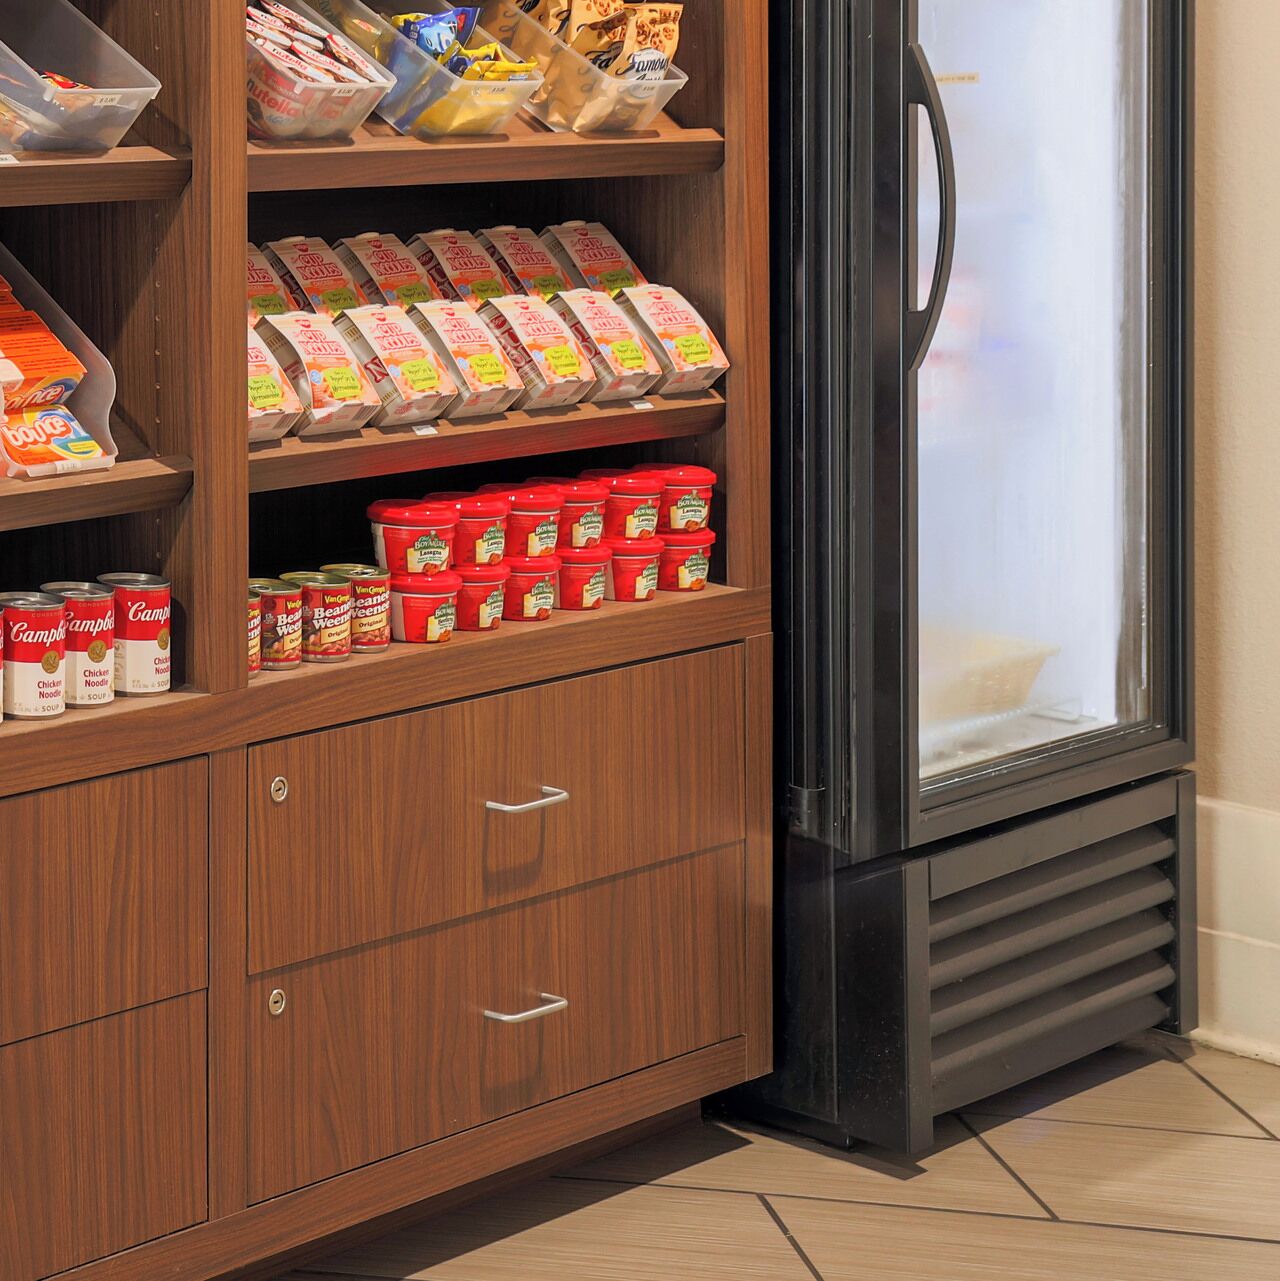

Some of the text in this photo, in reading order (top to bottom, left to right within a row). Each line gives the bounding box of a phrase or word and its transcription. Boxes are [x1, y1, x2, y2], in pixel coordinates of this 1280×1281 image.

[615, 50, 669, 76] Famous
[246, 77, 300, 118] nutella
[8, 415, 67, 447] bounce
[84, 679, 109, 688] Noodle
[38, 689, 62, 699] Noodle
[87, 692, 107, 701] SOUP
[41, 703, 59, 712] SOUP
